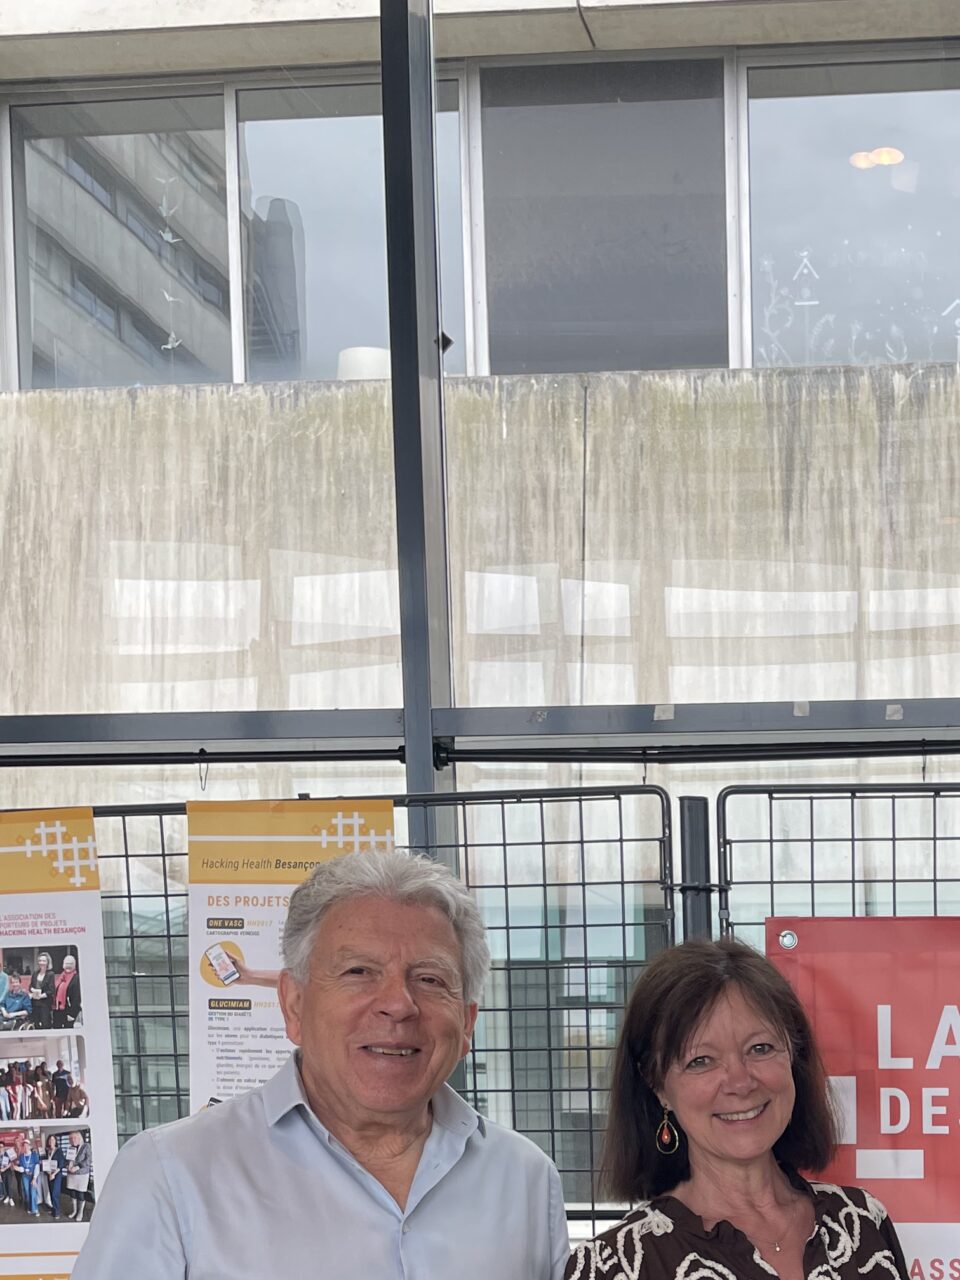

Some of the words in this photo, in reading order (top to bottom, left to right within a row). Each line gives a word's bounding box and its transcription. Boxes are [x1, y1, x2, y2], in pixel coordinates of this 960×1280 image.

[201, 859, 239, 871] Hacking
[241, 859, 272, 869] Health
[207, 896, 230, 907] DES
[235, 896, 290, 907] PROJETS
[53, 927, 86, 935] BESANÇON
